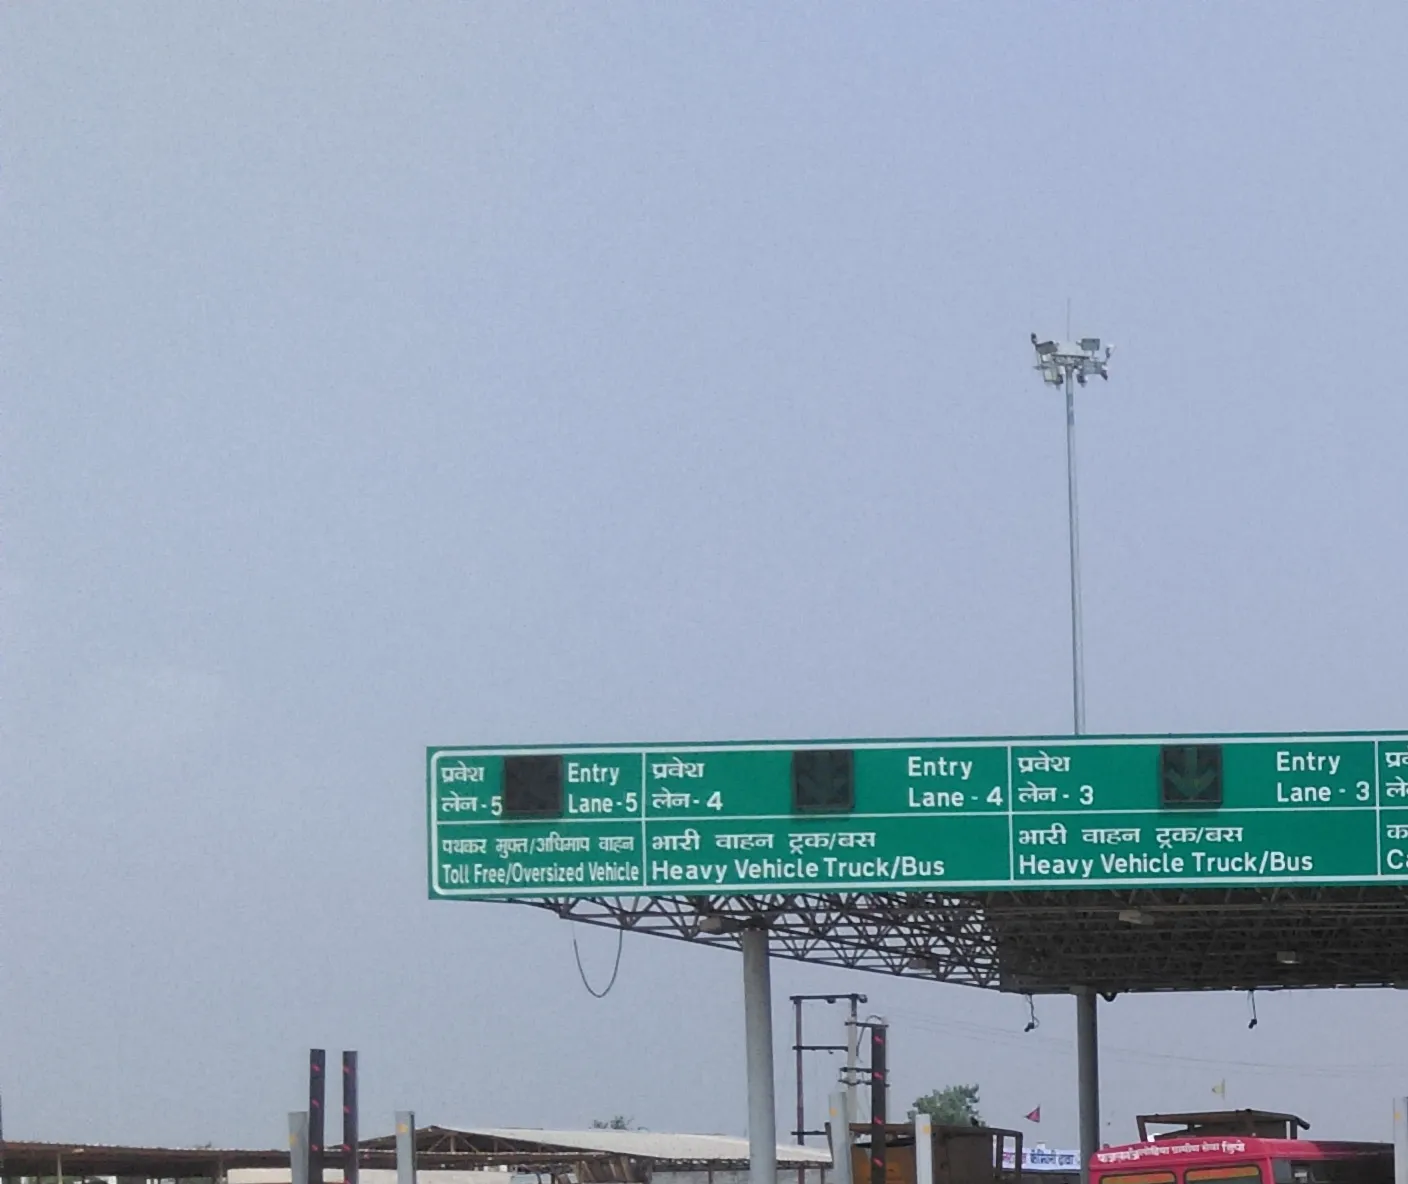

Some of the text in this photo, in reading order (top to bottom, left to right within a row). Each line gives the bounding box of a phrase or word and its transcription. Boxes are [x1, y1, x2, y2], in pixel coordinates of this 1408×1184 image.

[441, 761, 485, 783] प्रवेश
[652, 757, 705, 779] प्रवेश
[907, 756, 973, 780] Entry
[1018, 750, 1071, 773] प्रवेश
[1276, 751, 1341, 775] Entry
[567, 762, 620, 786] Entry
[441, 791, 478, 812] लेन
[652, 787, 690, 809] लेन
[706, 791, 723, 811] 4
[908, 788, 965, 807] Lane
[986, 786, 1004, 806] 4
[1018, 781, 1057, 803] लेन
[1079, 785, 1094, 805] 3
[1277, 782, 1332, 803] Lane
[1356, 781, 1370, 801] 3
[442, 839, 487, 854] पथकर
[599, 836, 635, 853] वाहन
[652, 828, 876, 855] भारी वाहन ट्रक/बस
[1019, 823, 1244, 849] भारी वाहन ट्रक/बस
[442, 861, 639, 885] Toll Free/Oversized Vehicle
[652, 856, 945, 883] Heavy Vehicle Truck/Bus
[1019, 851, 1313, 880] Heavy Vehicle Truck/Bus
